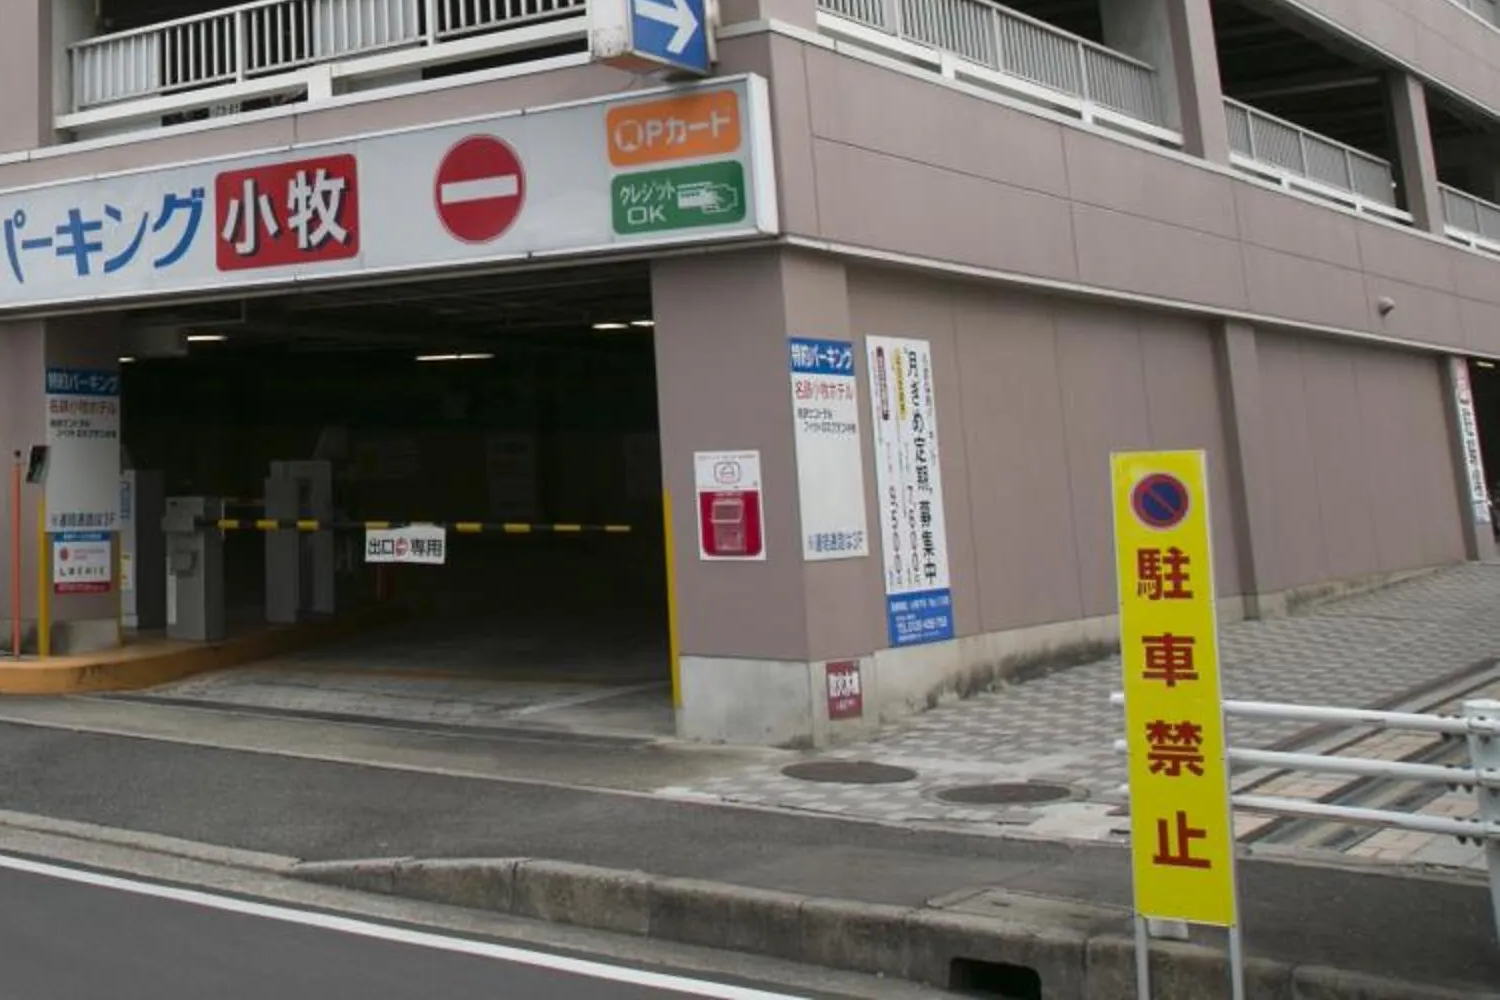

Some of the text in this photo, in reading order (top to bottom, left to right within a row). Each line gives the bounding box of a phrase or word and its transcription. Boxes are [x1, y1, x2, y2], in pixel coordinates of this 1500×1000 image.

[620, 180, 676, 206] クレジット
[221, 169, 349, 257] 小牧
[627, 205, 667, 225] OK
[369, 538, 393, 555] 出口
[1136, 546, 1211, 869] 駐車禁止
